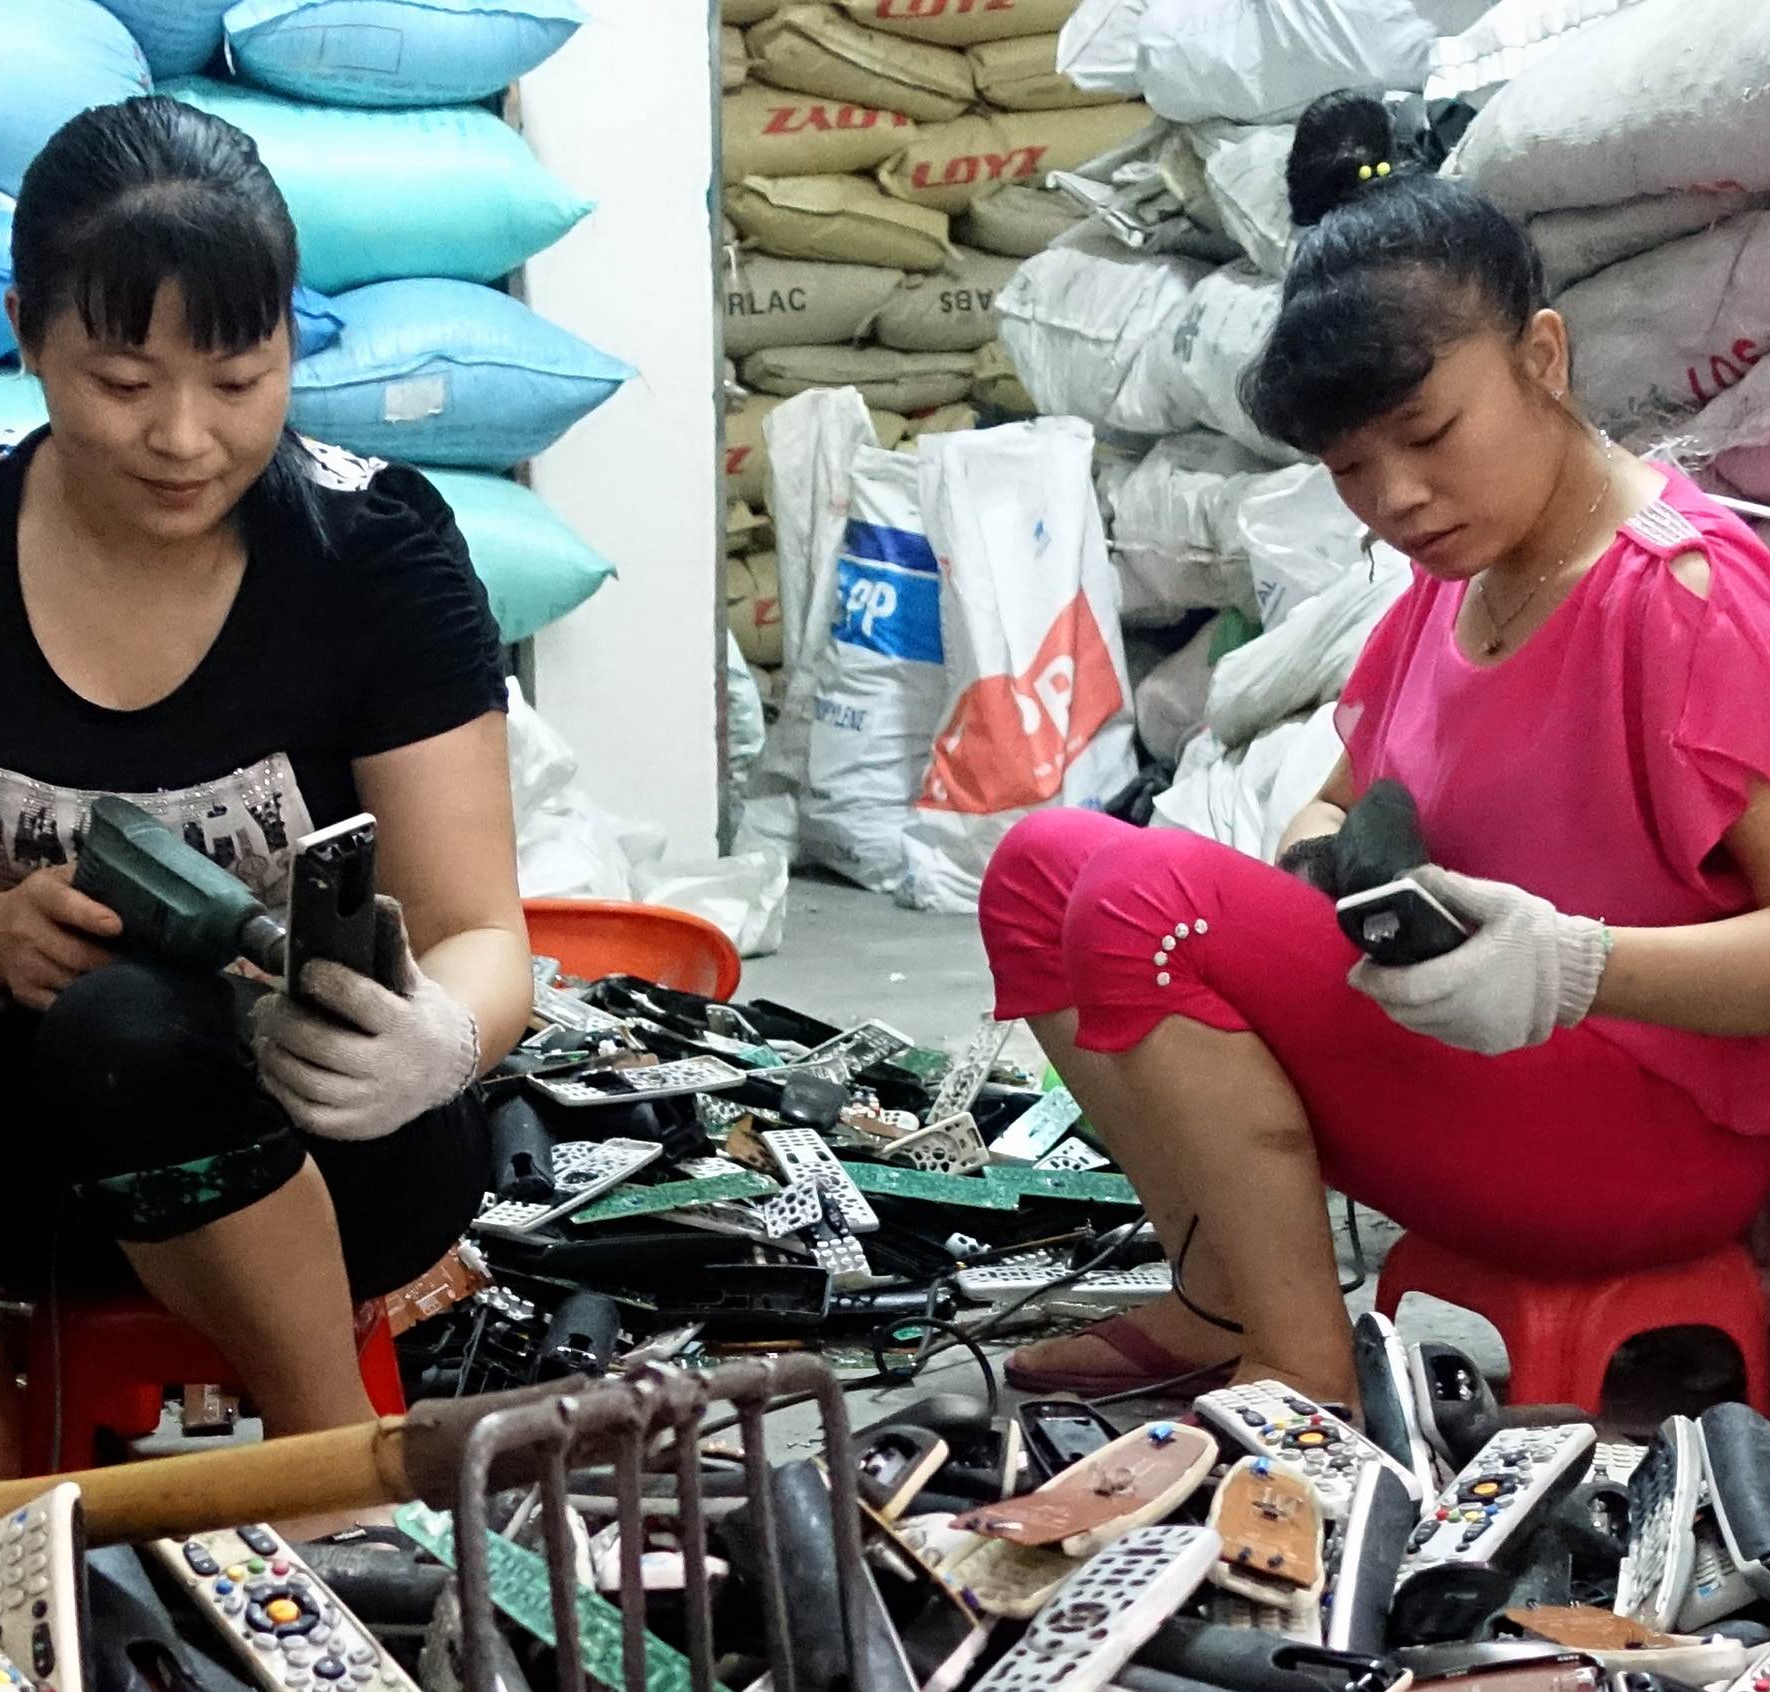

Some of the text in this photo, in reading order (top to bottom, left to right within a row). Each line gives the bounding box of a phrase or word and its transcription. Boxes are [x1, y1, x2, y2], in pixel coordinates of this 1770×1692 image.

[911, 146, 1048, 190] LOYZ
[723, 287, 807, 317] RLAC
[940, 288, 994, 313] ABS
